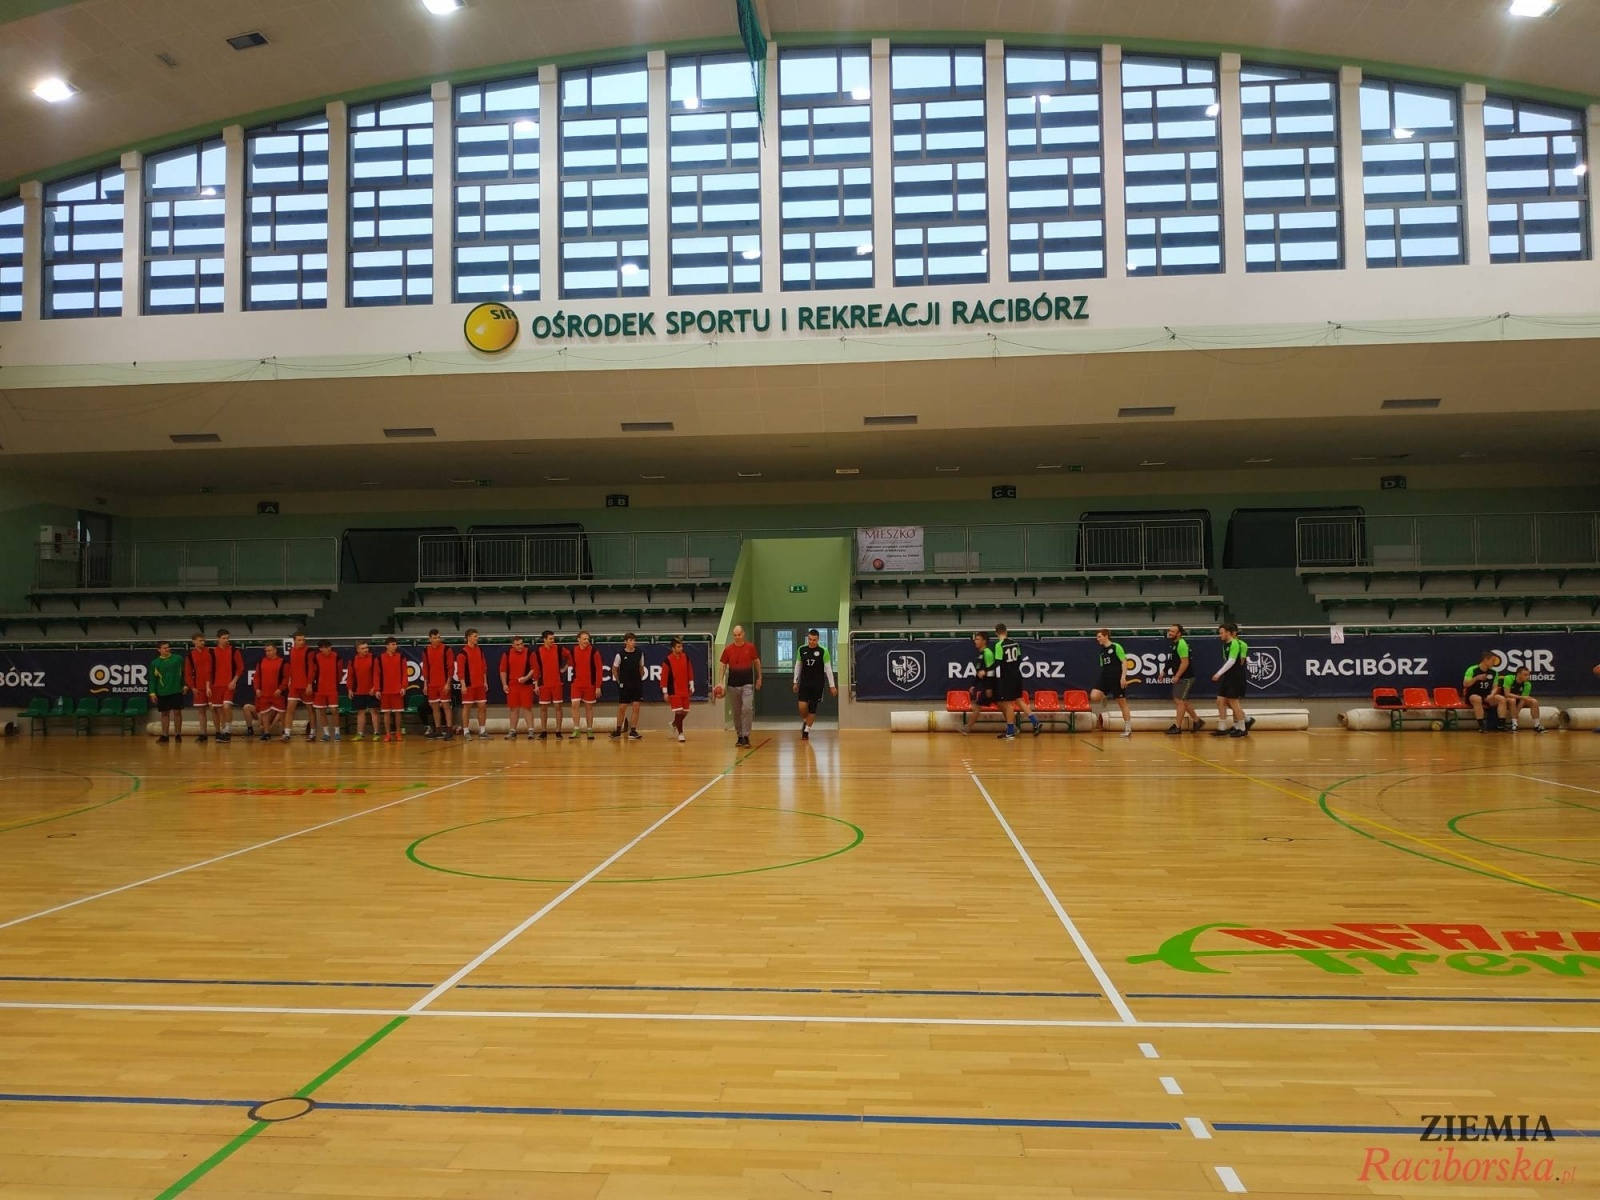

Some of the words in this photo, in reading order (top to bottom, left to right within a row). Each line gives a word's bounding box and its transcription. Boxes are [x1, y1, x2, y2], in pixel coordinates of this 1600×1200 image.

[532, 311, 656, 339] OŚRODEK
[666, 308, 770, 334] SPORTU
[781, 307, 787, 331] I
[798, 302, 940, 330] REKREACJI
[952, 292, 1089, 325] RACIBÓRZ
[617, 498, 626, 506] B
[264, 505, 276, 513] A
[865, 529, 916, 540] MIESZKO
[1004, 647, 1018, 663] 10
[806, 659, 816, 667] 17
[948, 656, 1066, 679] RAIÓRZ
[1305, 653, 1429, 676] RACIBÓRZ
[89, 664, 148, 686] OSiR
[1479, 681, 1489, 689] 19
